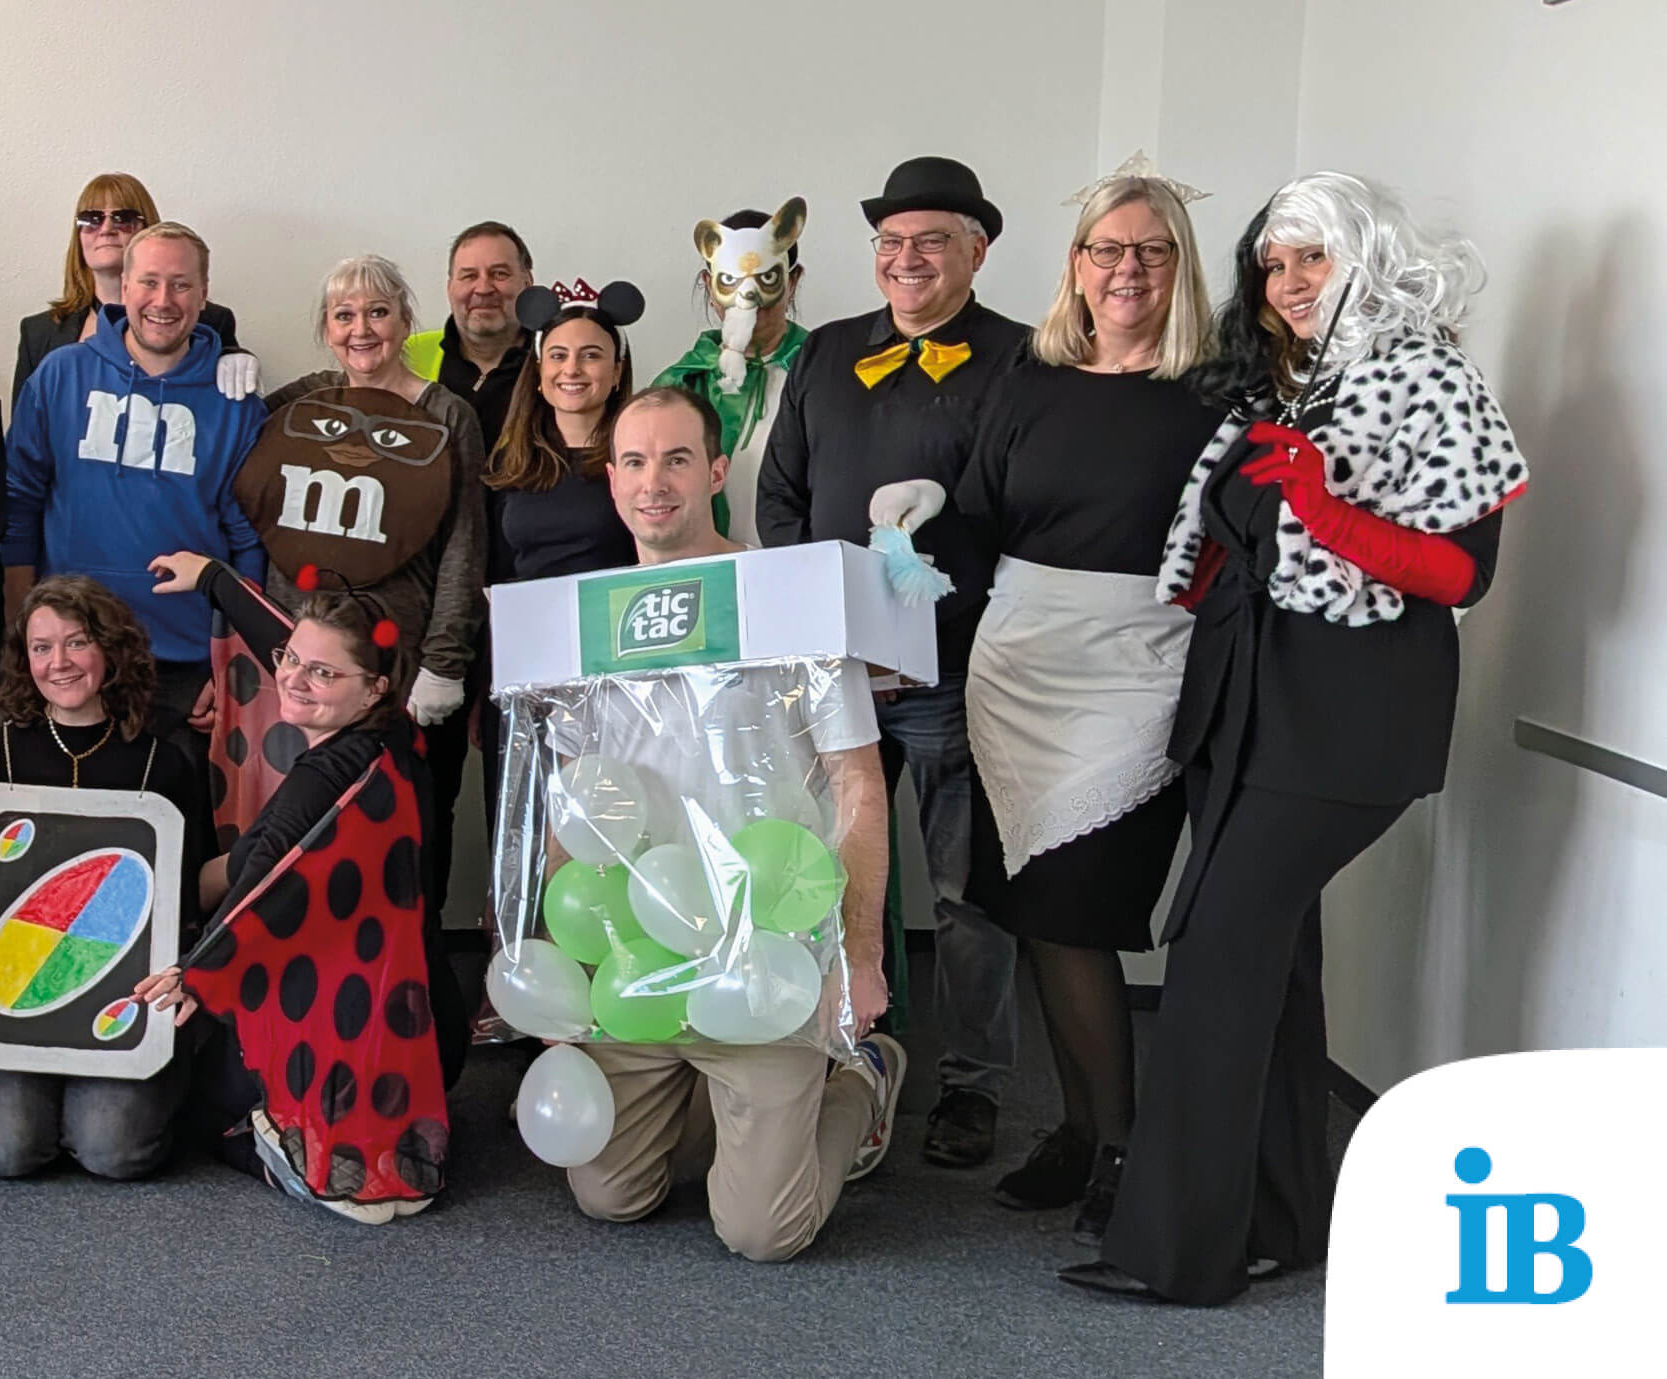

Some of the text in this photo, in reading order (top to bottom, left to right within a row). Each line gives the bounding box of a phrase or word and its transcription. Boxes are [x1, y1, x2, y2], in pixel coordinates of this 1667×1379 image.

[79, 390, 196, 476] m
[277, 464, 387, 543] m
[632, 614, 688, 641] tac
[644, 589, 690, 618] tic
